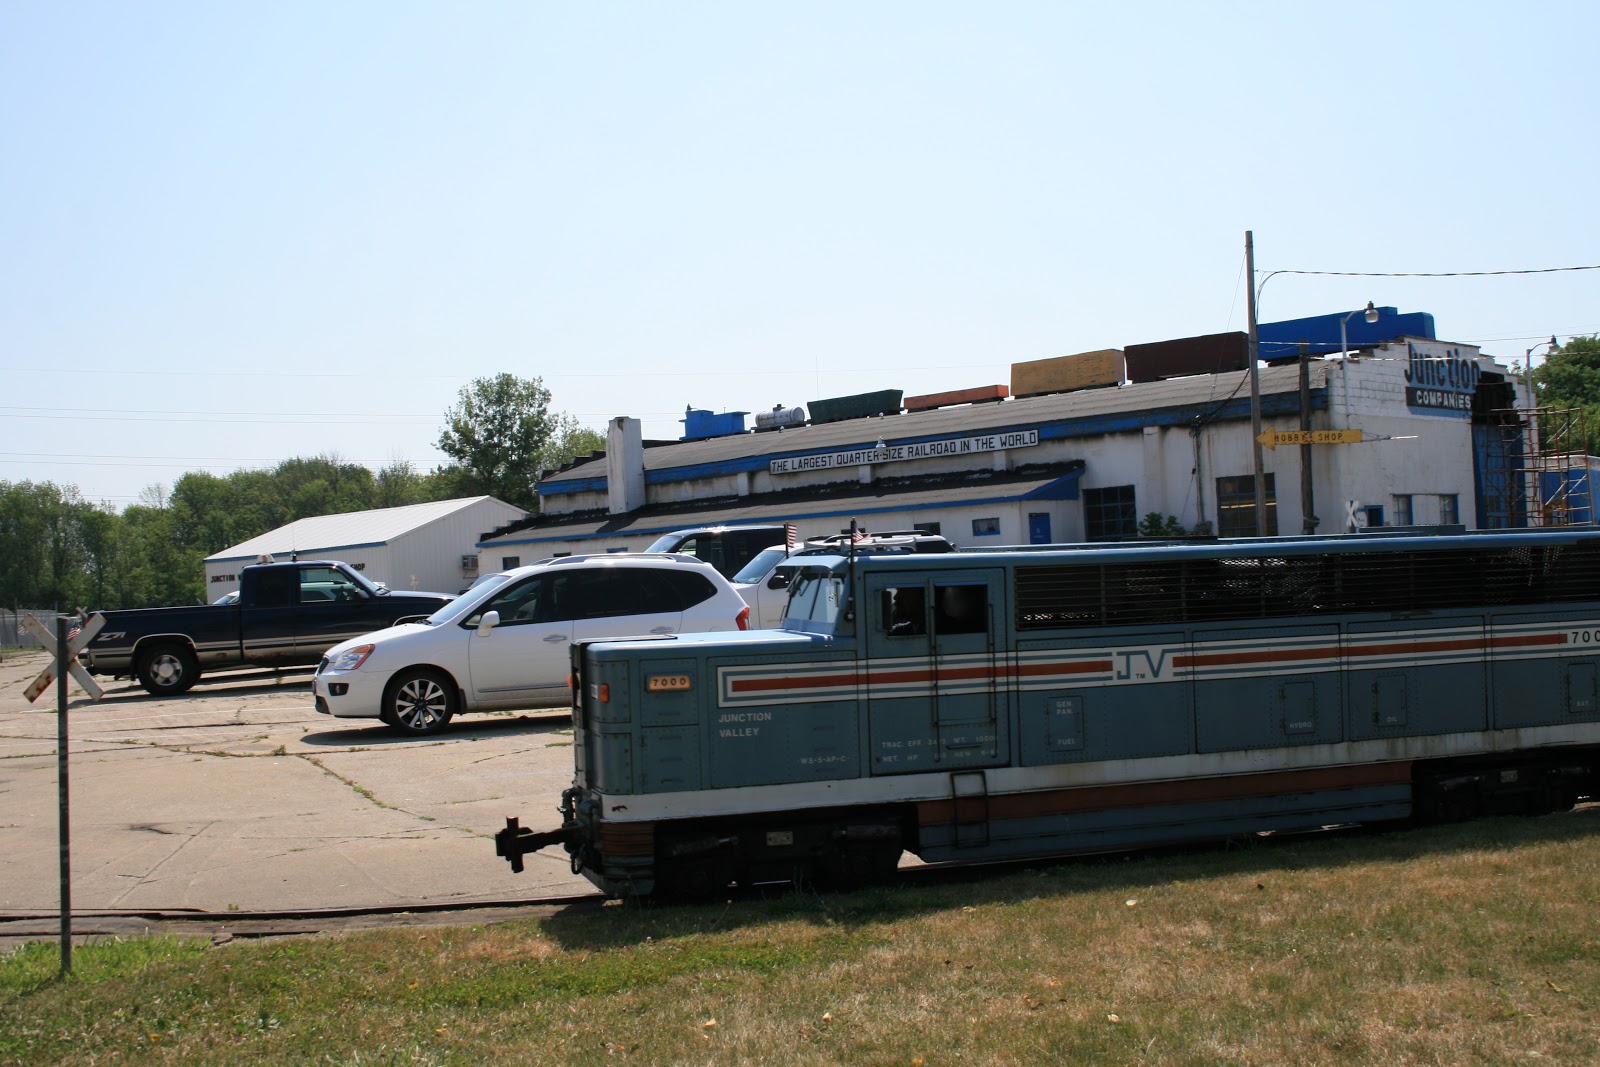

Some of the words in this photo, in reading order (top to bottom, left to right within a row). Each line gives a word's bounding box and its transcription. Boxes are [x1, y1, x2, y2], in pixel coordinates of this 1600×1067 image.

[1404, 342, 1480, 390] Junction
[1416, 390, 1471, 409] COMPANIES
[1274, 434, 1306, 442] HOBBY
[1318, 433, 1343, 441] SHOP
[772, 460, 788, 471] THE
[792, 455, 833, 470] LARGEST
[836, 447, 904, 465] QUARTER-SIZE
[907, 441, 956, 458] RAILROAD
[960, 441, 970, 452] IN
[975, 437, 995, 450] THE
[1000, 432, 1037, 447] WORLD
[210, 574, 235, 583] JUNCTION
[653, 677, 687, 687] 7000
[718, 712, 772, 723] JUNCTION
[1289, 721, 1313, 729] HYDRO
[719, 727, 760, 738] VALLEY
[1057, 738, 1076, 746] FUEL
